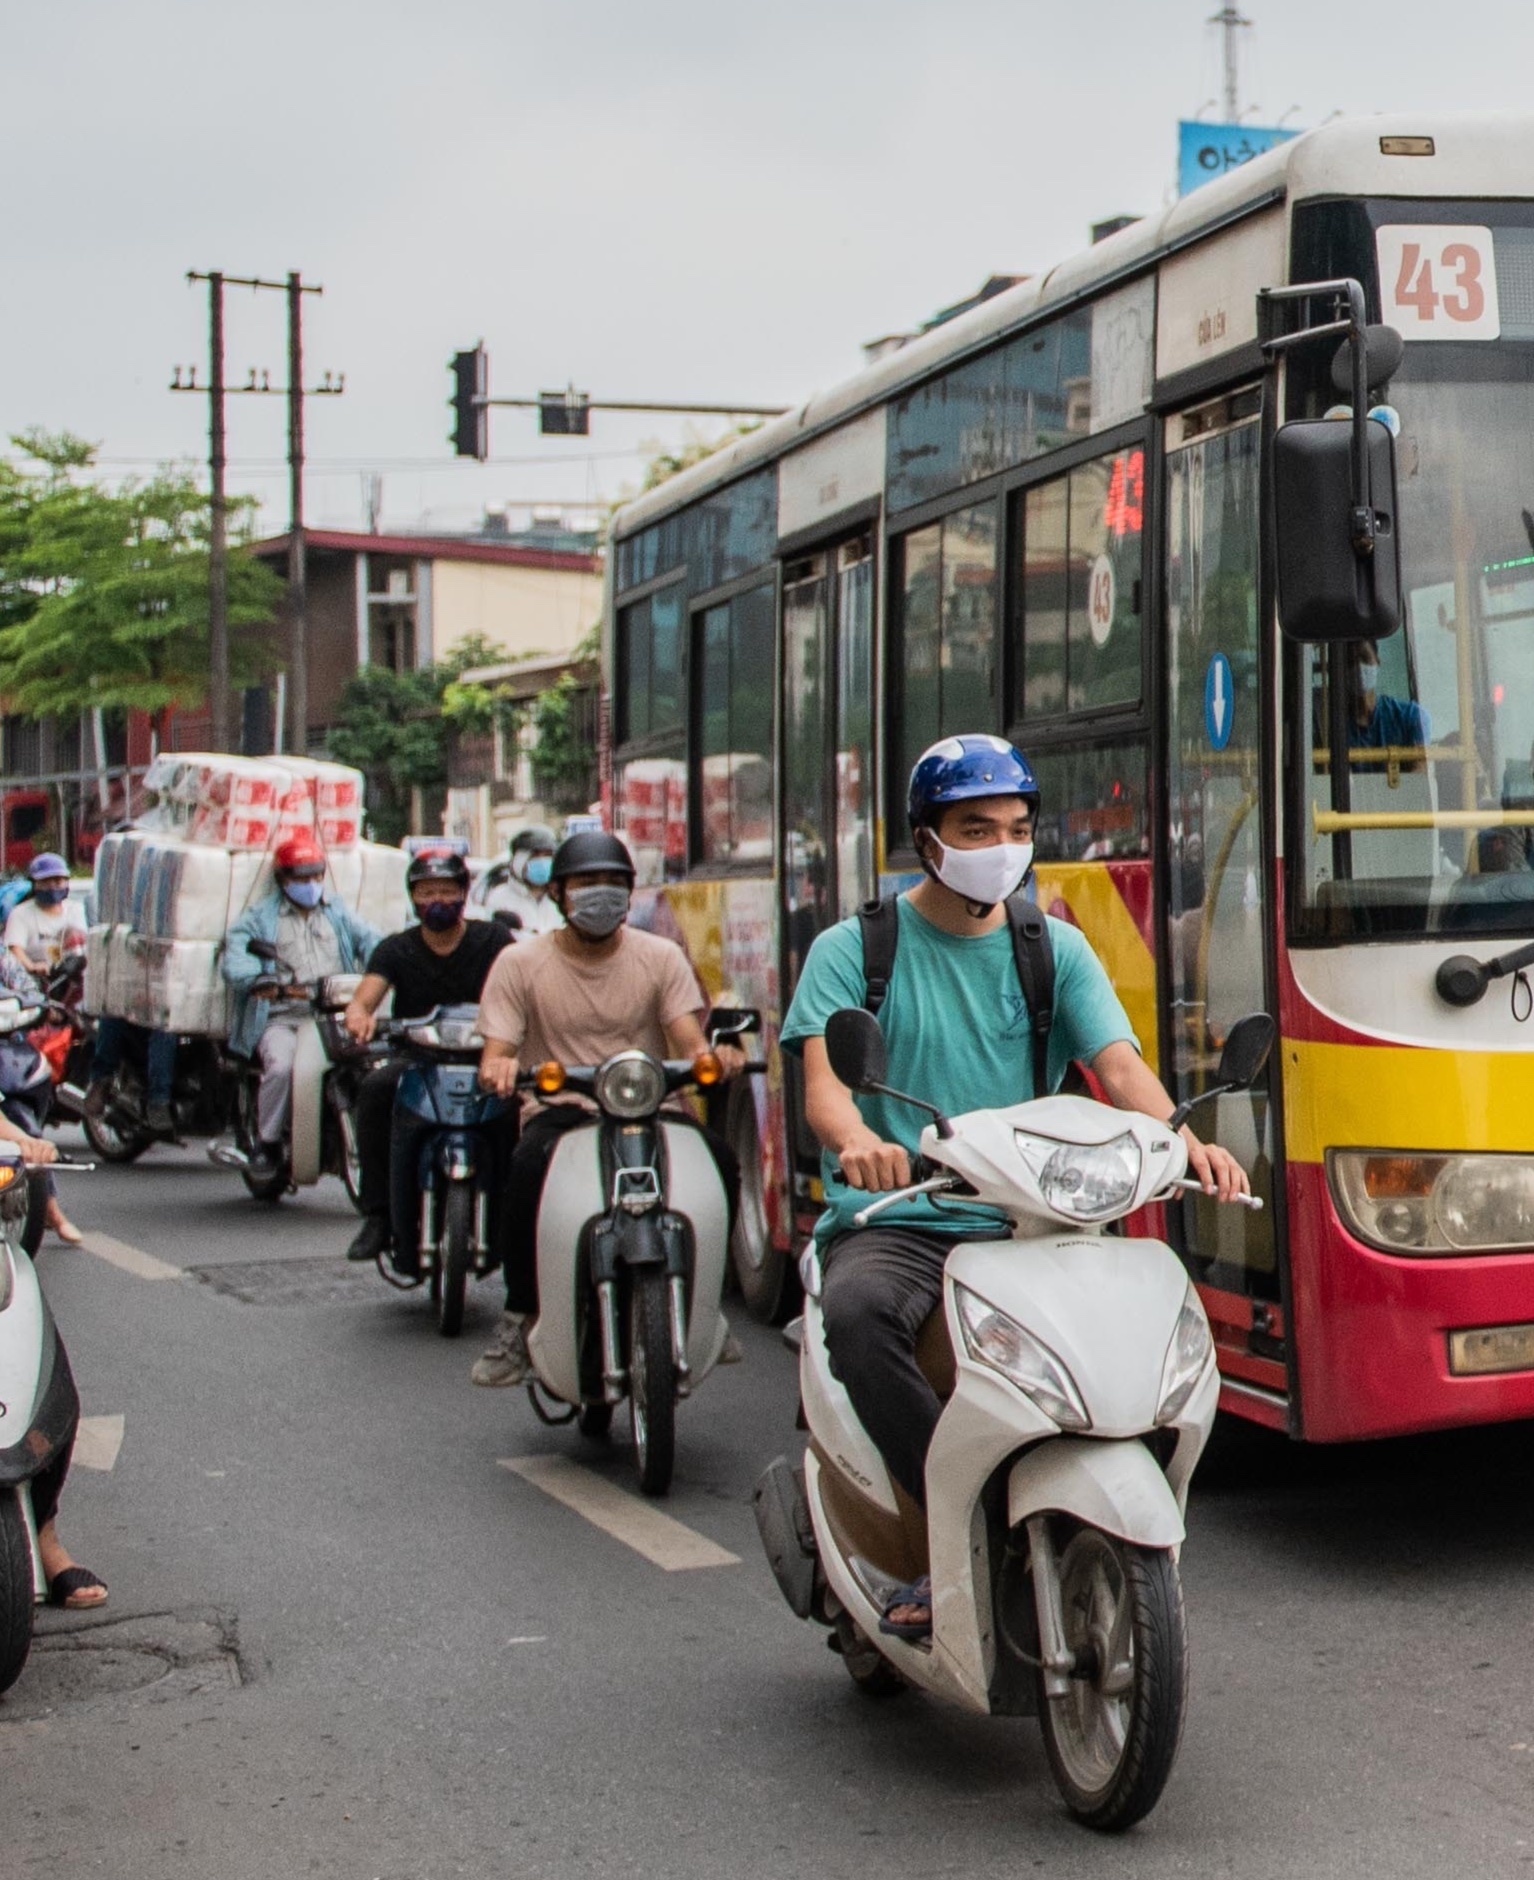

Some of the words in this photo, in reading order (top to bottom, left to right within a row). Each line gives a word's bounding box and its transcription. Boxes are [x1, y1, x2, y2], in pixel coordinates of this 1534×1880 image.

[1394, 243, 1485, 323] 43
[1105, 451, 1143, 535] 43
[1093, 572, 1110, 624] 43
